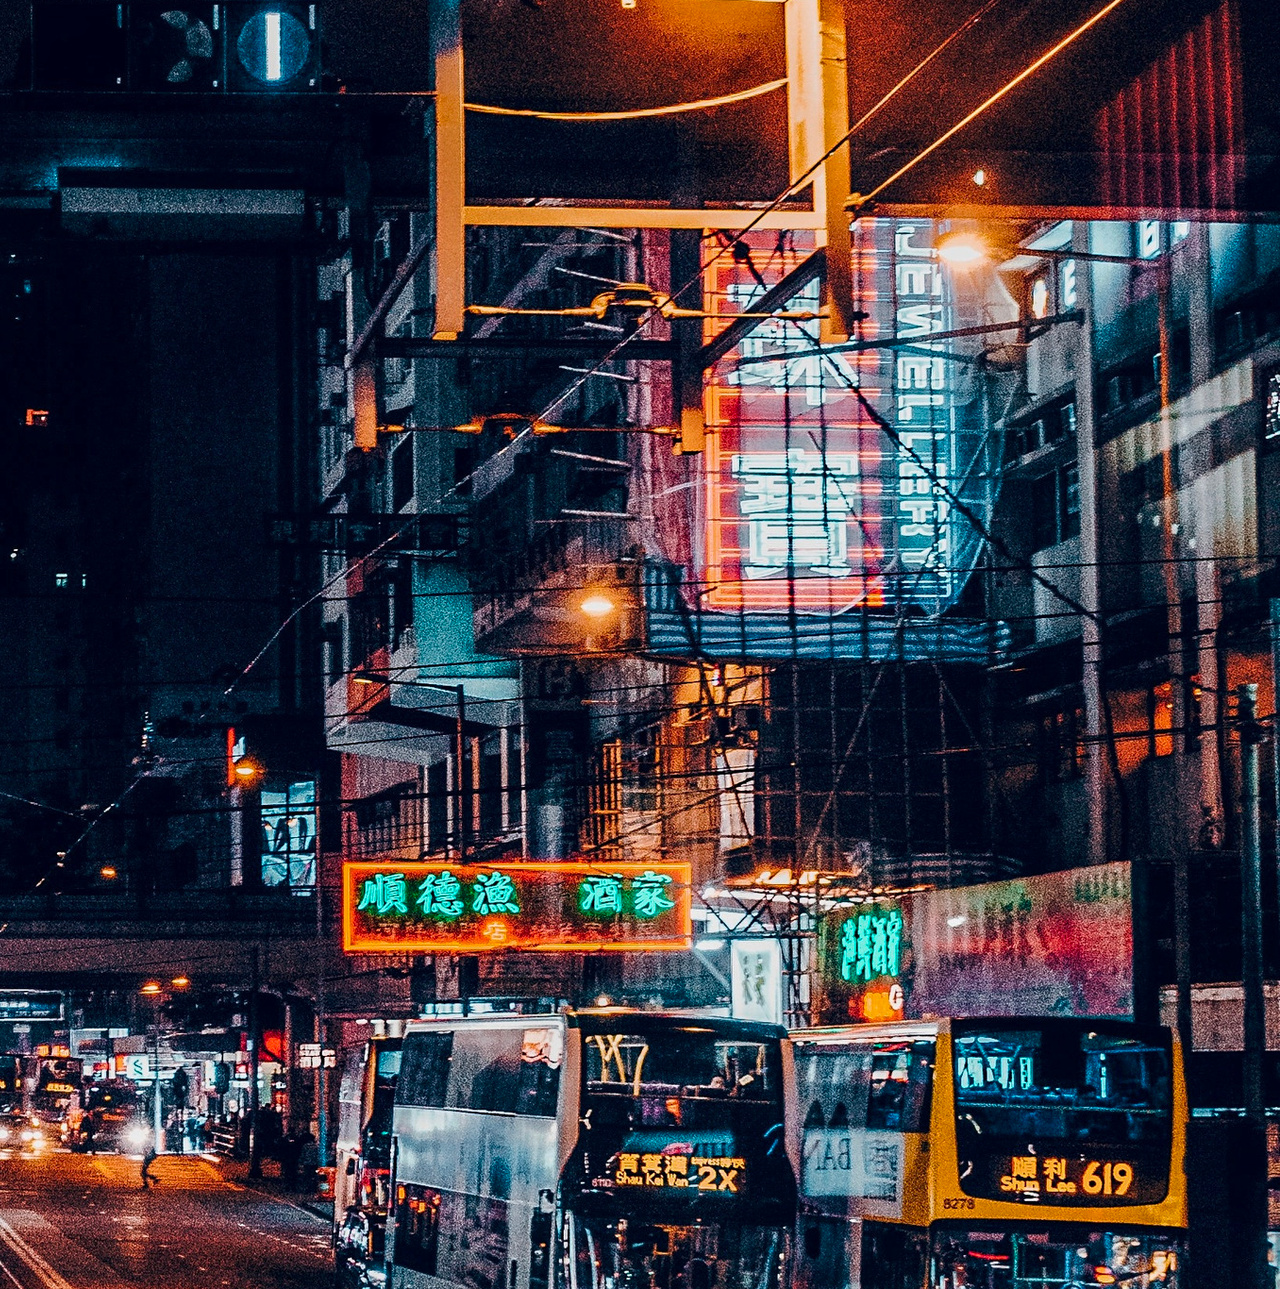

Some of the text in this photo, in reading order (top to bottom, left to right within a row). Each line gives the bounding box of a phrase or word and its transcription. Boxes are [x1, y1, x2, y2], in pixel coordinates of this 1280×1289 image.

[580, 870, 676, 915] 酒家
[616, 1171, 689, 1187] Shau Kei Wan
[698, 1167, 738, 1192] 2X
[1011, 1156, 1066, 1180] 順利
[1082, 1161, 1134, 1196] 619
[1001, 1176, 1076, 1193] Shun Lee
